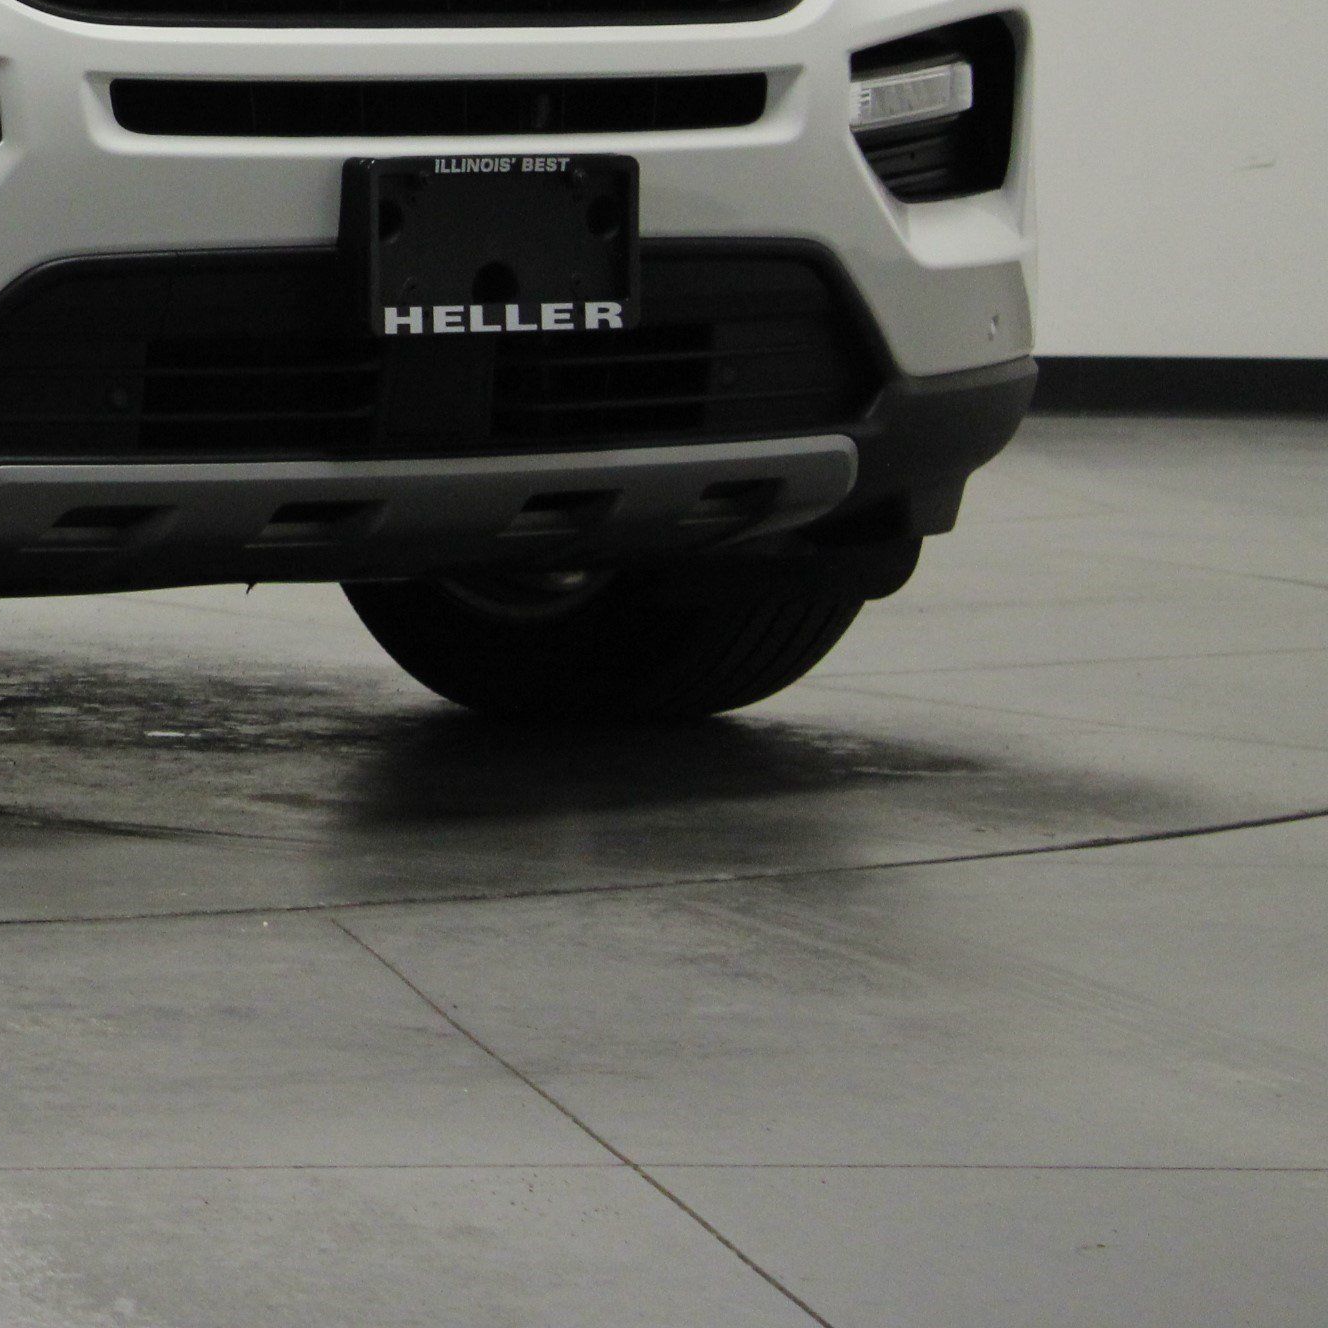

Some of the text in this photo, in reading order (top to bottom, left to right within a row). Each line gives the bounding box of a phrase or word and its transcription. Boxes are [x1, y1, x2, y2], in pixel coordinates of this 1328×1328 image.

[433, 157, 571, 174] ILLINOIS' BEST
[383, 301, 624, 335] HELLER
